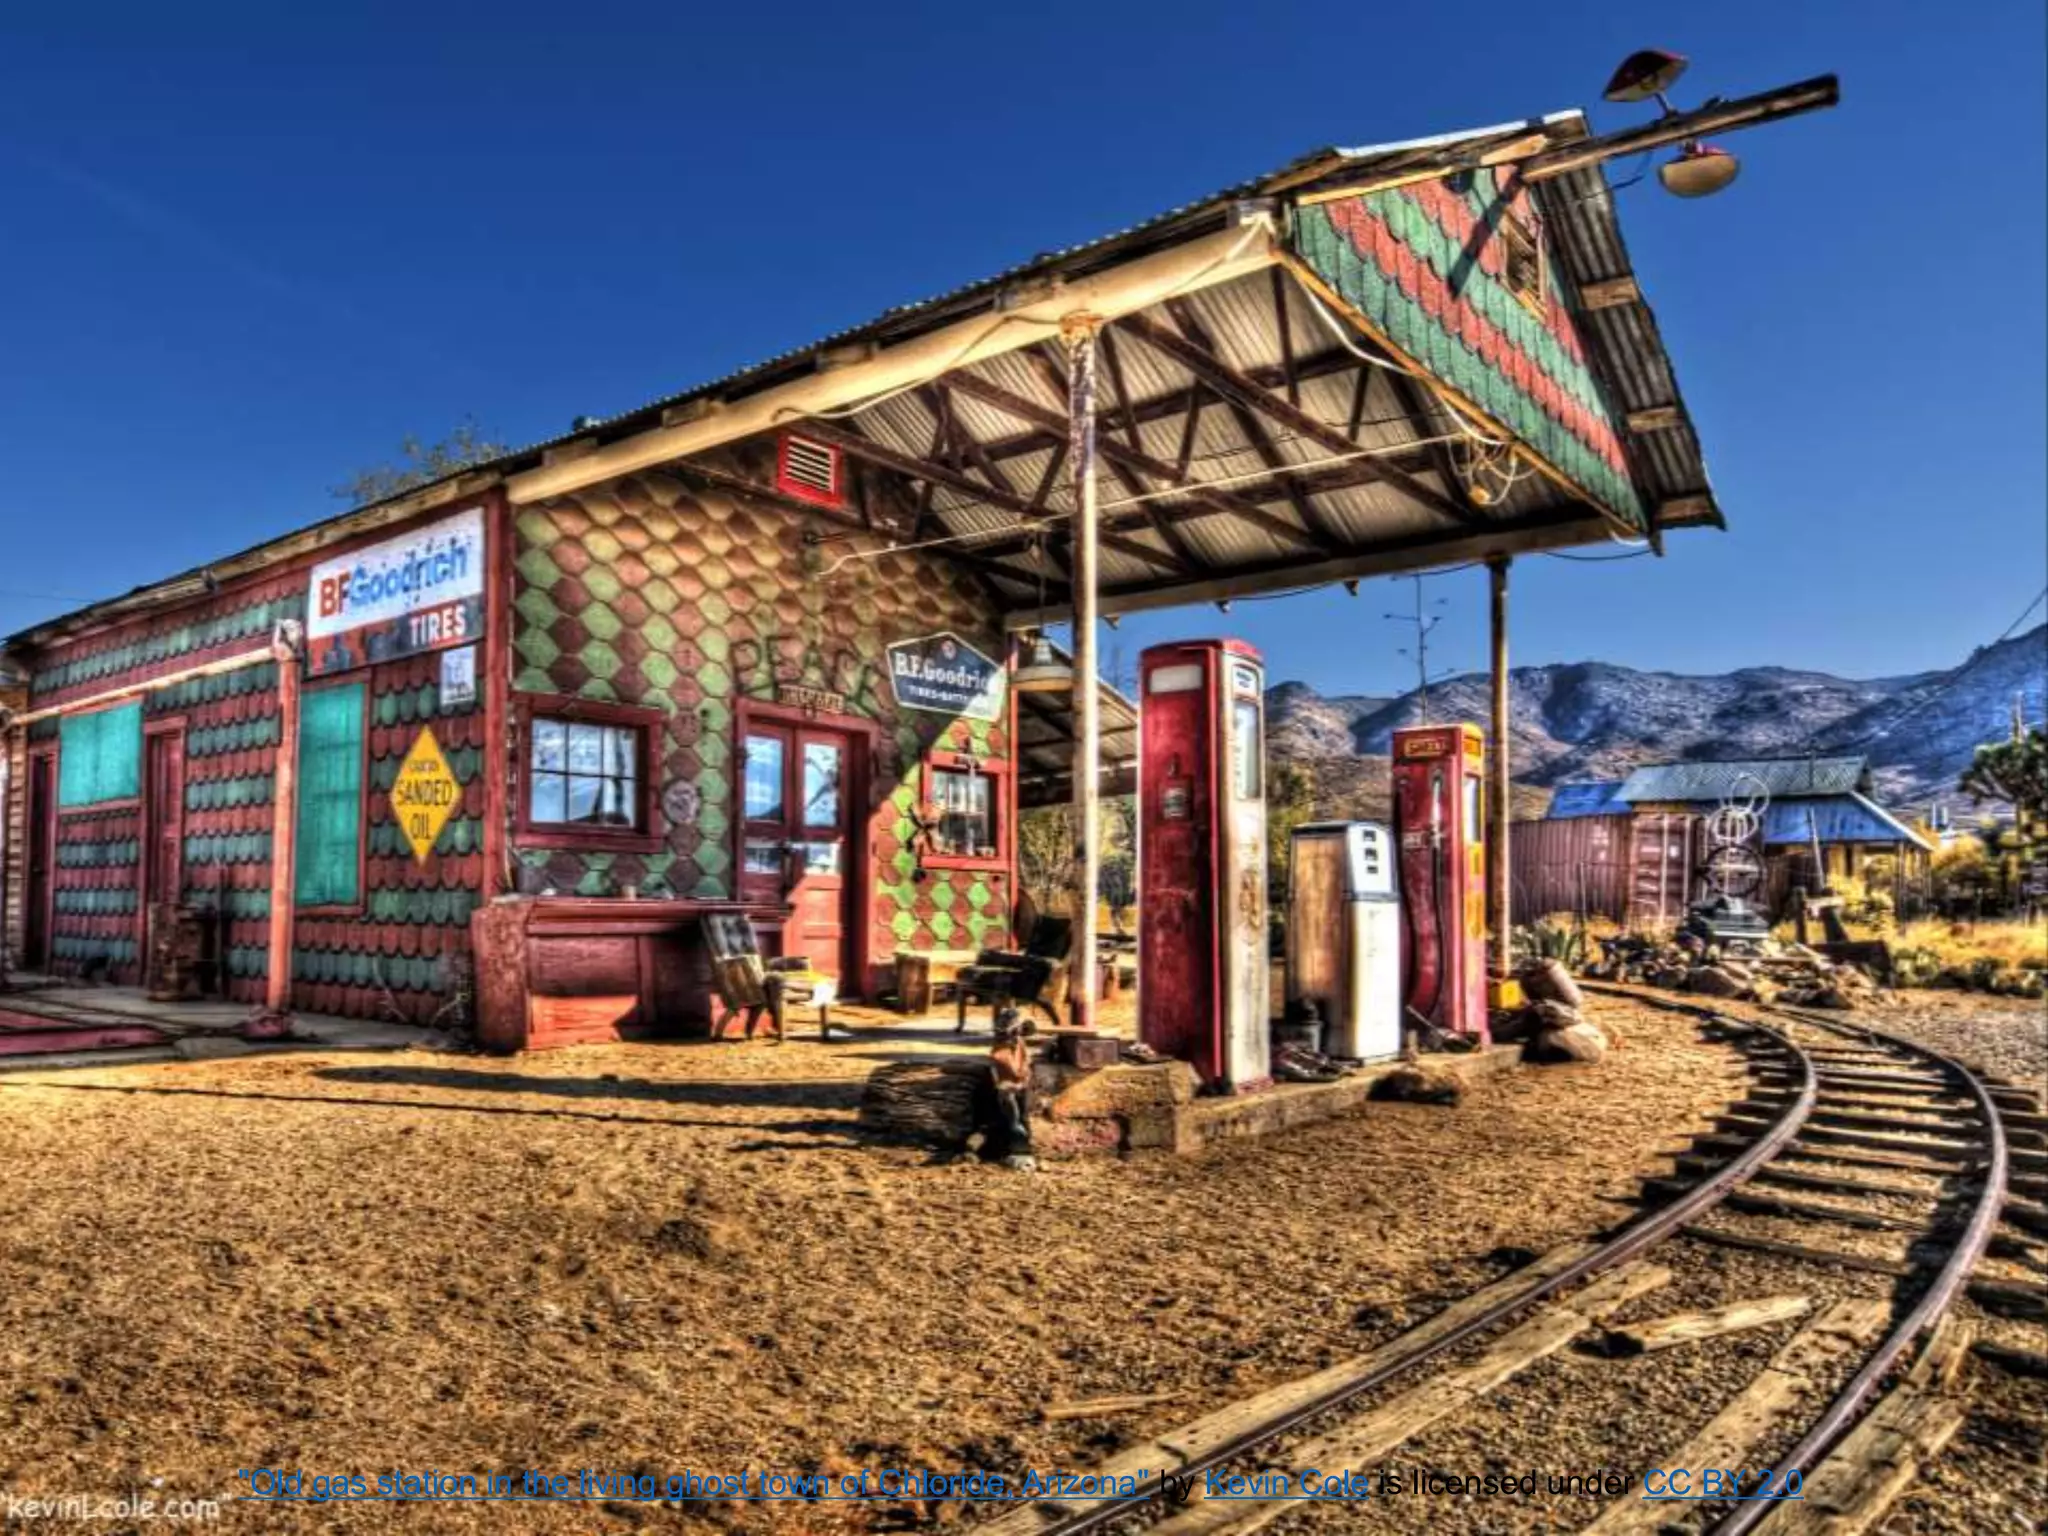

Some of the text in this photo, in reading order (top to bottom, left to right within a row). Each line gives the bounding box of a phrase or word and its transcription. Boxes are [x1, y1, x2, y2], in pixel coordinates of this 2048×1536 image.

[409, 604, 467, 646] TIRES
[396, 779, 452, 806] SANDED
[410, 813, 431, 840] OIL
